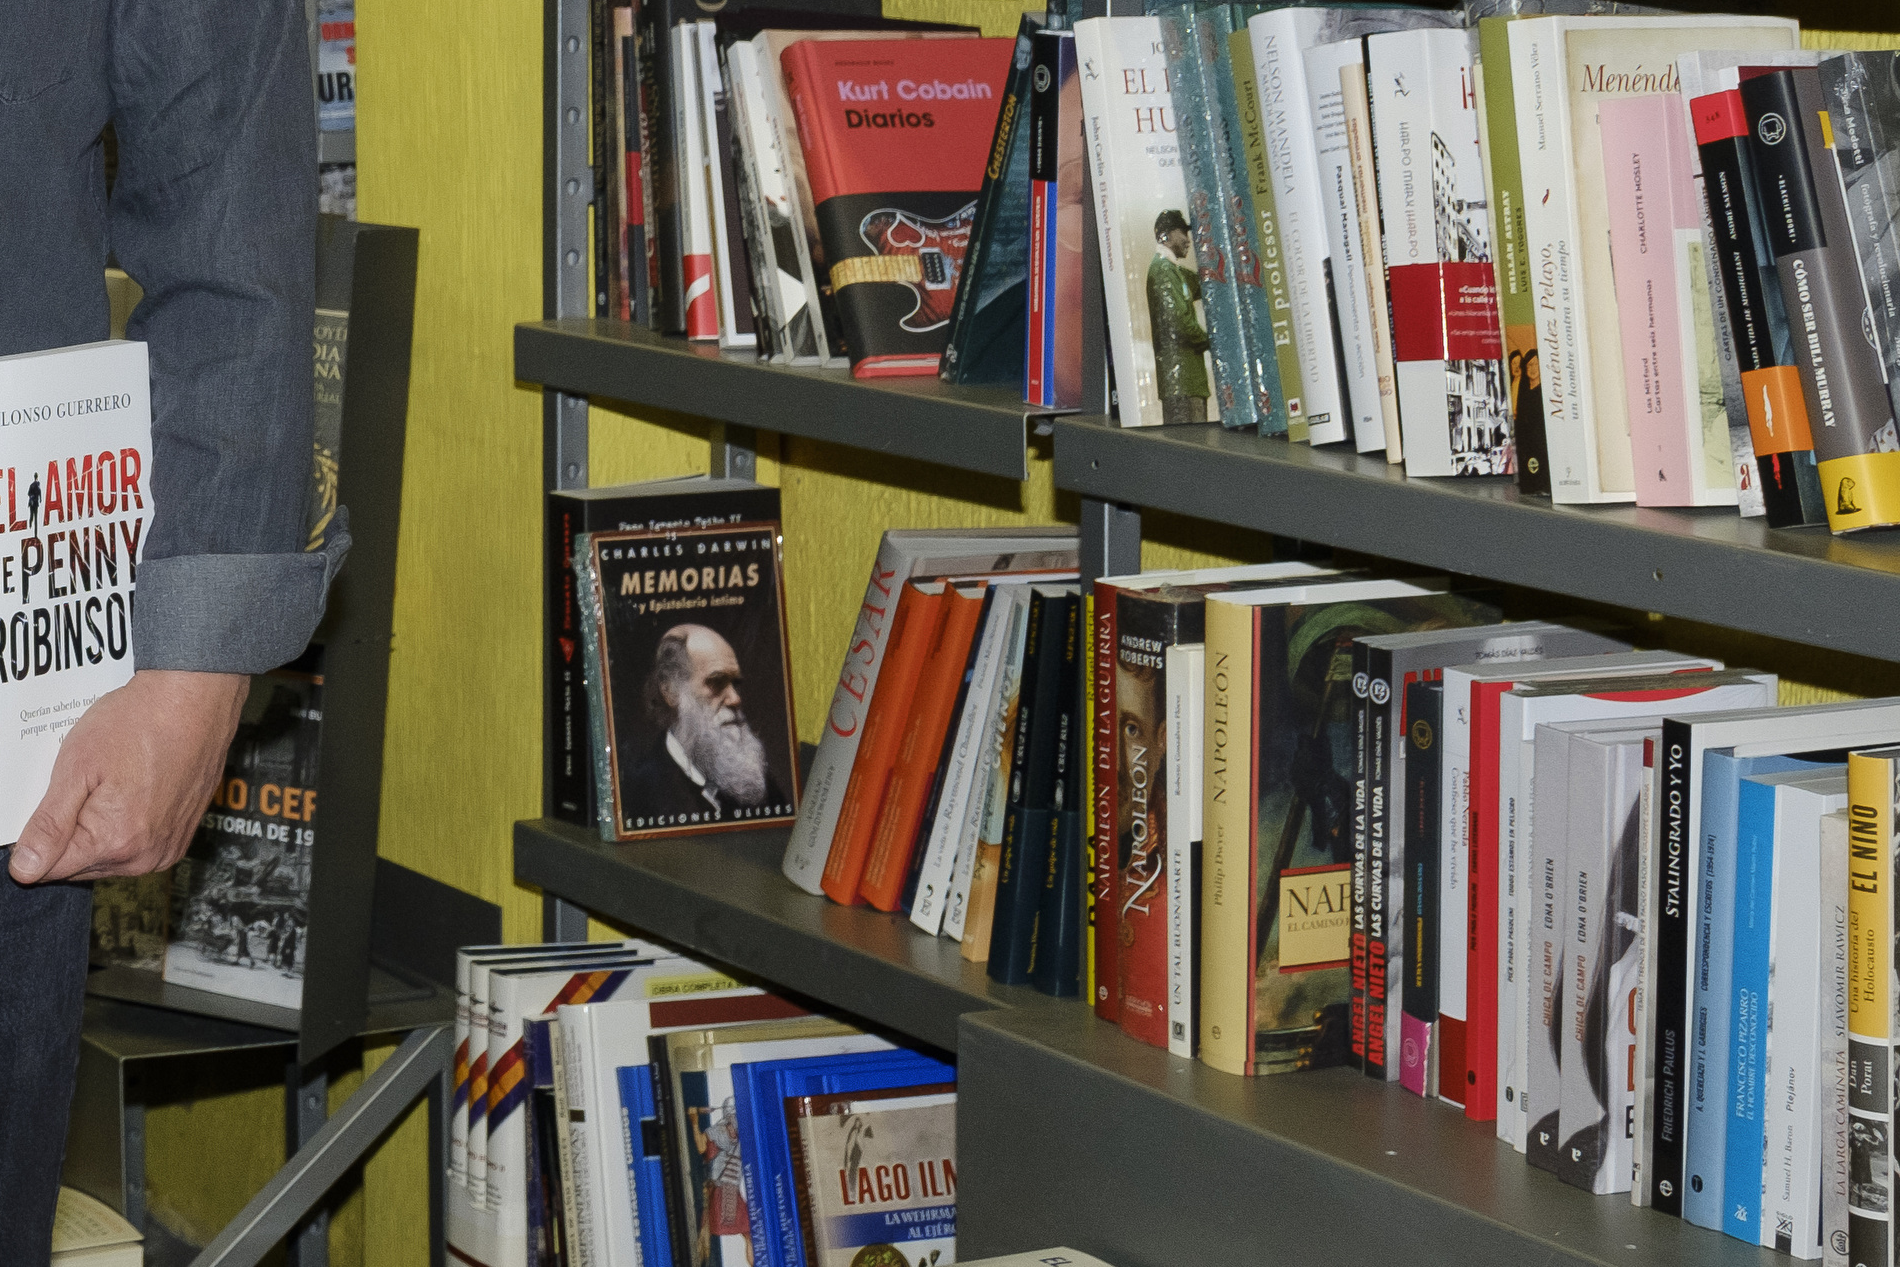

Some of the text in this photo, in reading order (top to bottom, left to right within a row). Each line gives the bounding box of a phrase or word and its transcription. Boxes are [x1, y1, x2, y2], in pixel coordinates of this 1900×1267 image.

[837, 79, 992, 102] Kurt Cobain
[1581, 64, 1680, 93] Menénde
[845, 109, 935, 129] Diarios
[987, 93, 1017, 180] CHESTERTON
[1243, 80, 1269, 196] Frank McCourt
[1335, 165, 1353, 264] Pasqual Maragall
[1631, 152, 1647, 255] CHARLOTTE MOSLEY
[1259, 209, 1291, 347] El profesor
[1539, 241, 1566, 422] Menéndez Pelayo,
[1792, 259, 1836, 428] CÓMO SER BILL MURRAY
[56, 393, 132, 420] GUERRERO
[43, 448, 145, 529] AMOR
[21, 517, 143, 605] PENNY
[600, 538, 772, 562] CHARLES DARWIN
[620, 563, 760, 596] MEMORIAS
[1120, 649, 1163, 669] ROBERTS
[1121, 634, 1162, 653] ANDREW
[19, 697, 81, 722] Querían saberlo
[20, 716, 80, 740] porque querían
[1213, 651, 1230, 805] NAPOLEÓN
[625, 803, 793, 829] EDICIONES ULISES
[1372, 786, 1384, 818] VIDA
[266, 823, 315, 847] DE 19
[1121, 745, 1162, 917] NAPOLEÓN
[1372, 822, 1383, 839] LA
[1372, 840, 1383, 859] DE
[1665, 744, 1683, 918] STALINGRADO Y YO
[1852, 803, 1878, 894] EL NIÑO
[1214, 862, 1224, 907] Philip
[1371, 860, 1383, 911] CURVAS
[1371, 913, 1382, 938] LAS
[1543, 858, 1554, 1027] CHICA DE CAMPO EDNA O'BRIEN
[1369, 941, 1385, 1000] NIETO
[1864, 928, 1874, 1004] Holocausto
[1735, 986, 1749, 1119] FRANCISCO PIZARRO
[1836, 905, 1846, 1197] LA LARGA CAMINATA SLAVOMIR RAWICZ
[1662, 1029, 1675, 1142] FRIEDRICH PAULUS
[1860, 1060, 1873, 1096] Porat
[840, 1162, 911, 1206] LAGO
